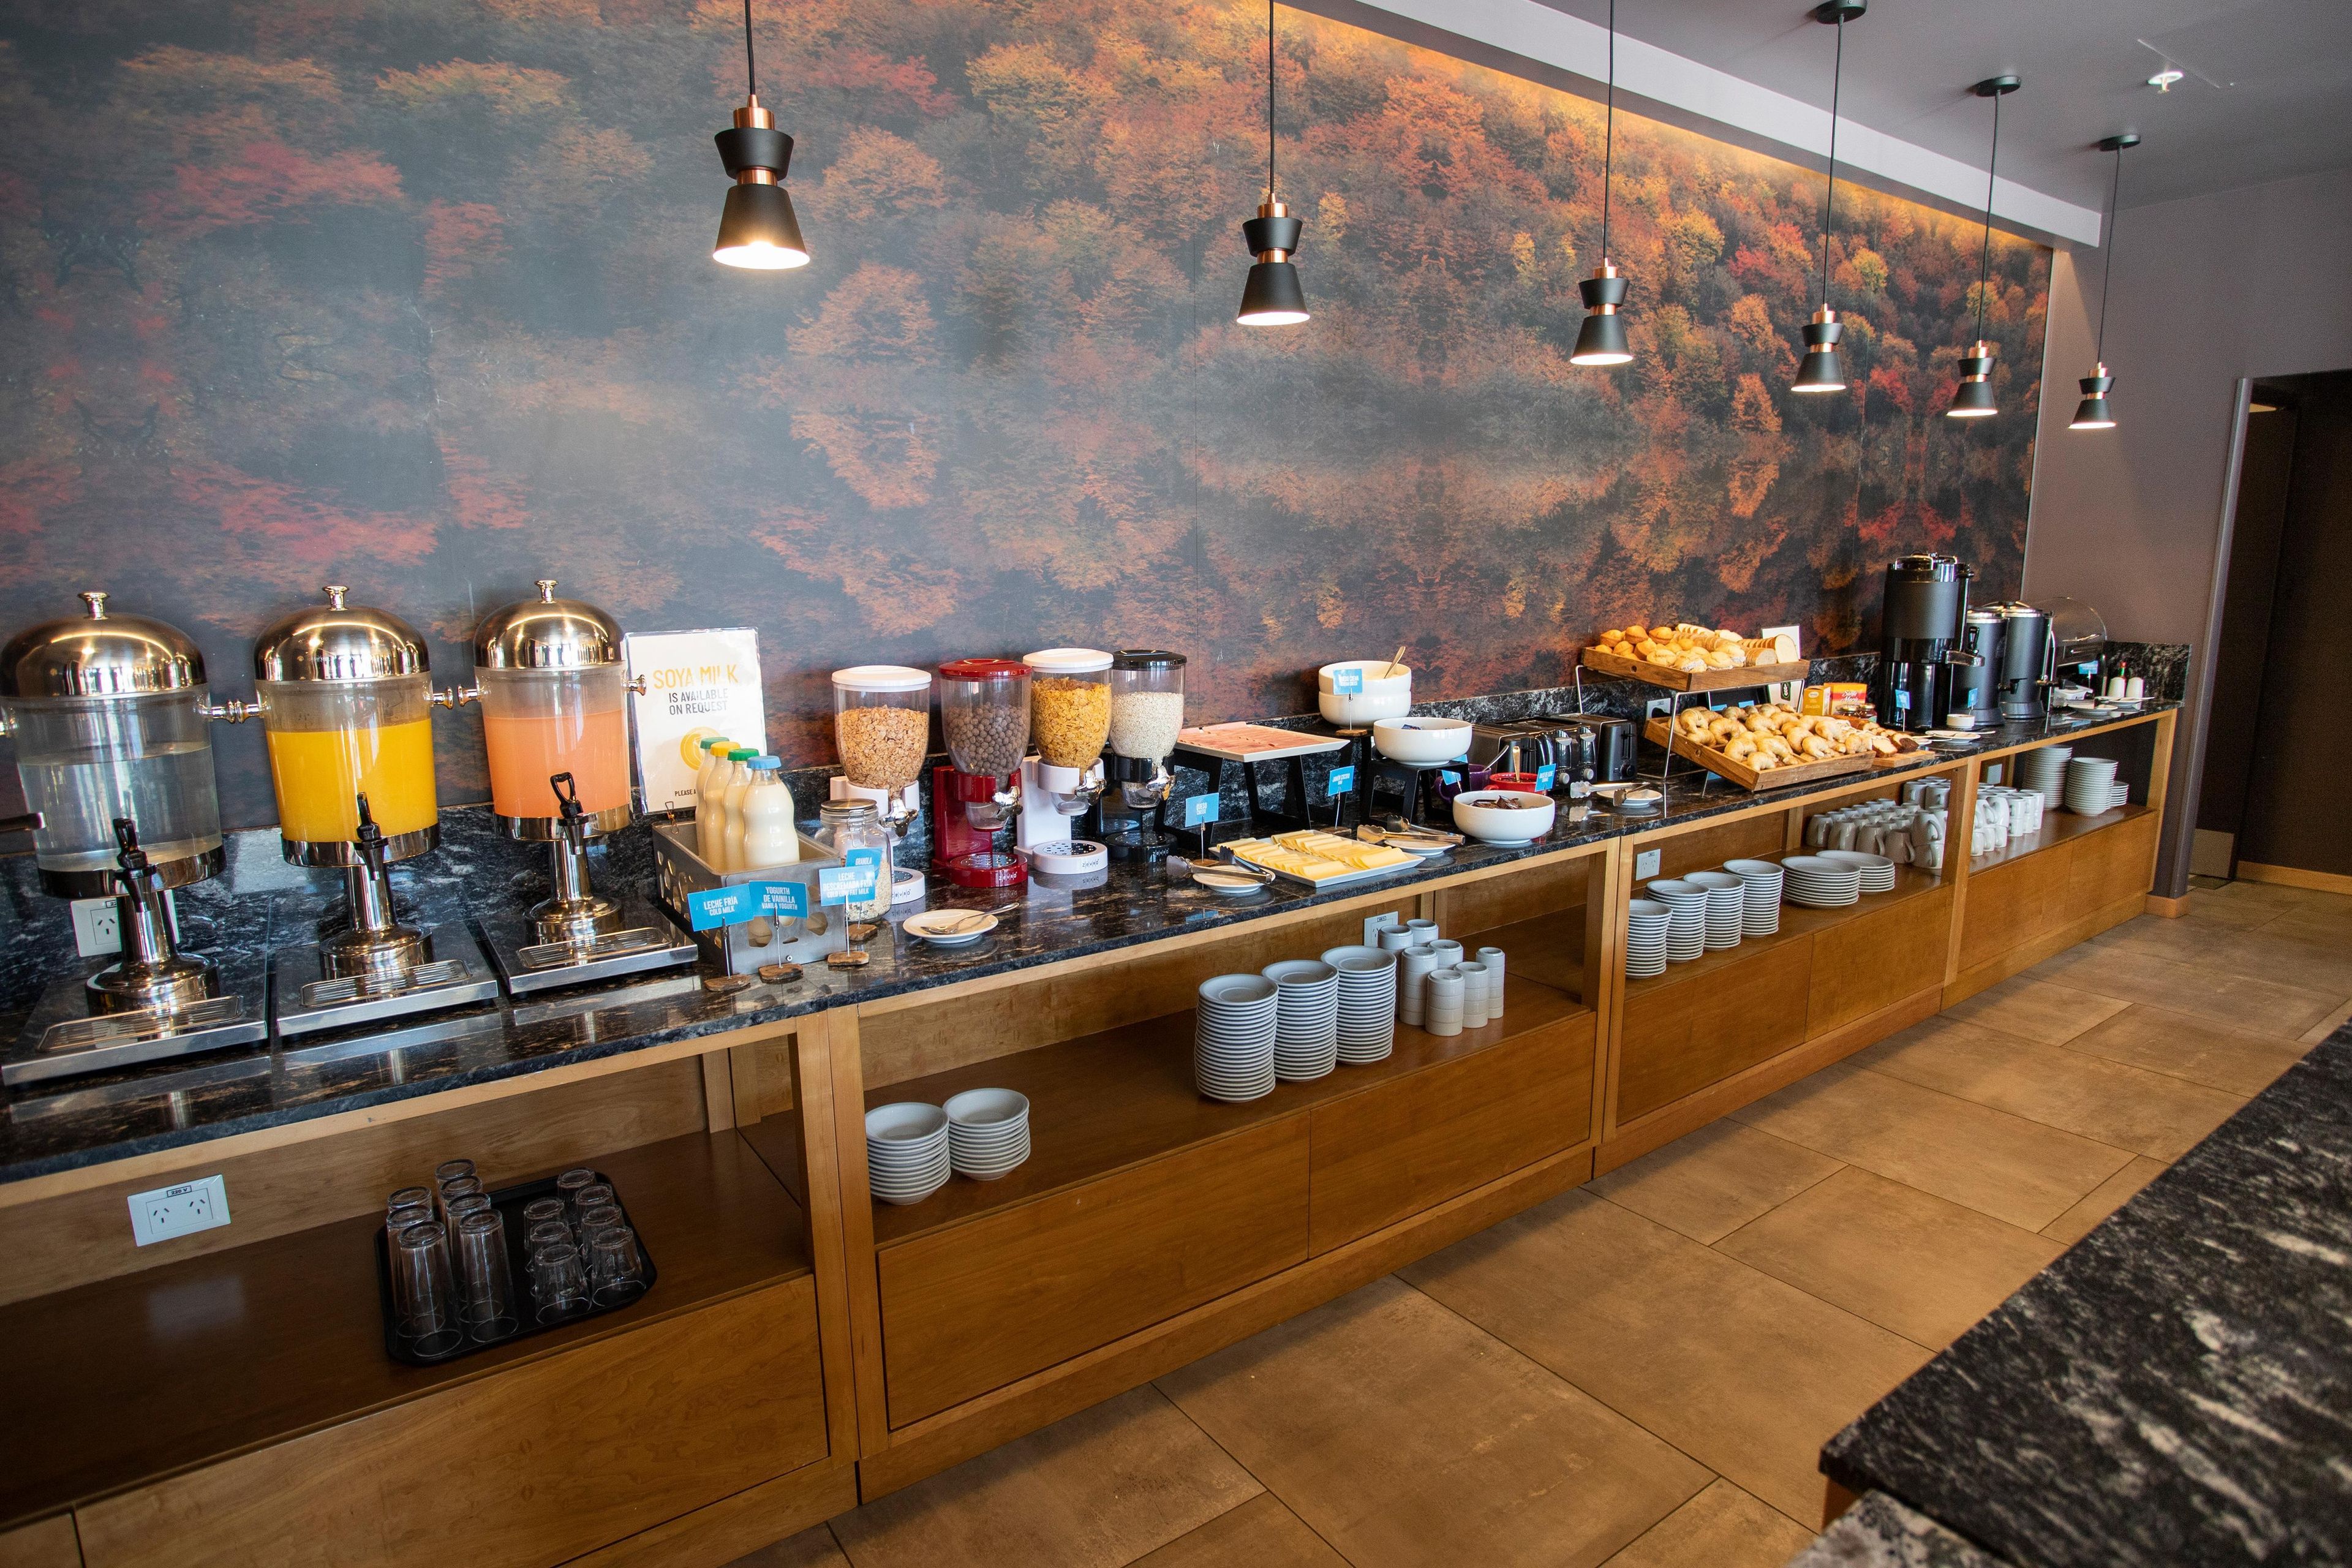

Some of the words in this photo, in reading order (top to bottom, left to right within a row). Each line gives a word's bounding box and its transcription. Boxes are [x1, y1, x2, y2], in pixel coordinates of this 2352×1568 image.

[653, 668, 694, 689] SOYA
[669, 693, 678, 703] IS
[681, 688, 728, 702] AVAILABLE
[669, 704, 683, 715] ON
[686, 701, 728, 714] REQUEST
[855, 857, 872, 865] GRANOLA
[838, 872, 856, 881] LECHE
[765, 886, 790, 895] YOGURTH
[703, 899, 723, 910] LECHE
[723, 895, 738, 907] FRÍA
[772, 895, 795, 903] VAINILLA
